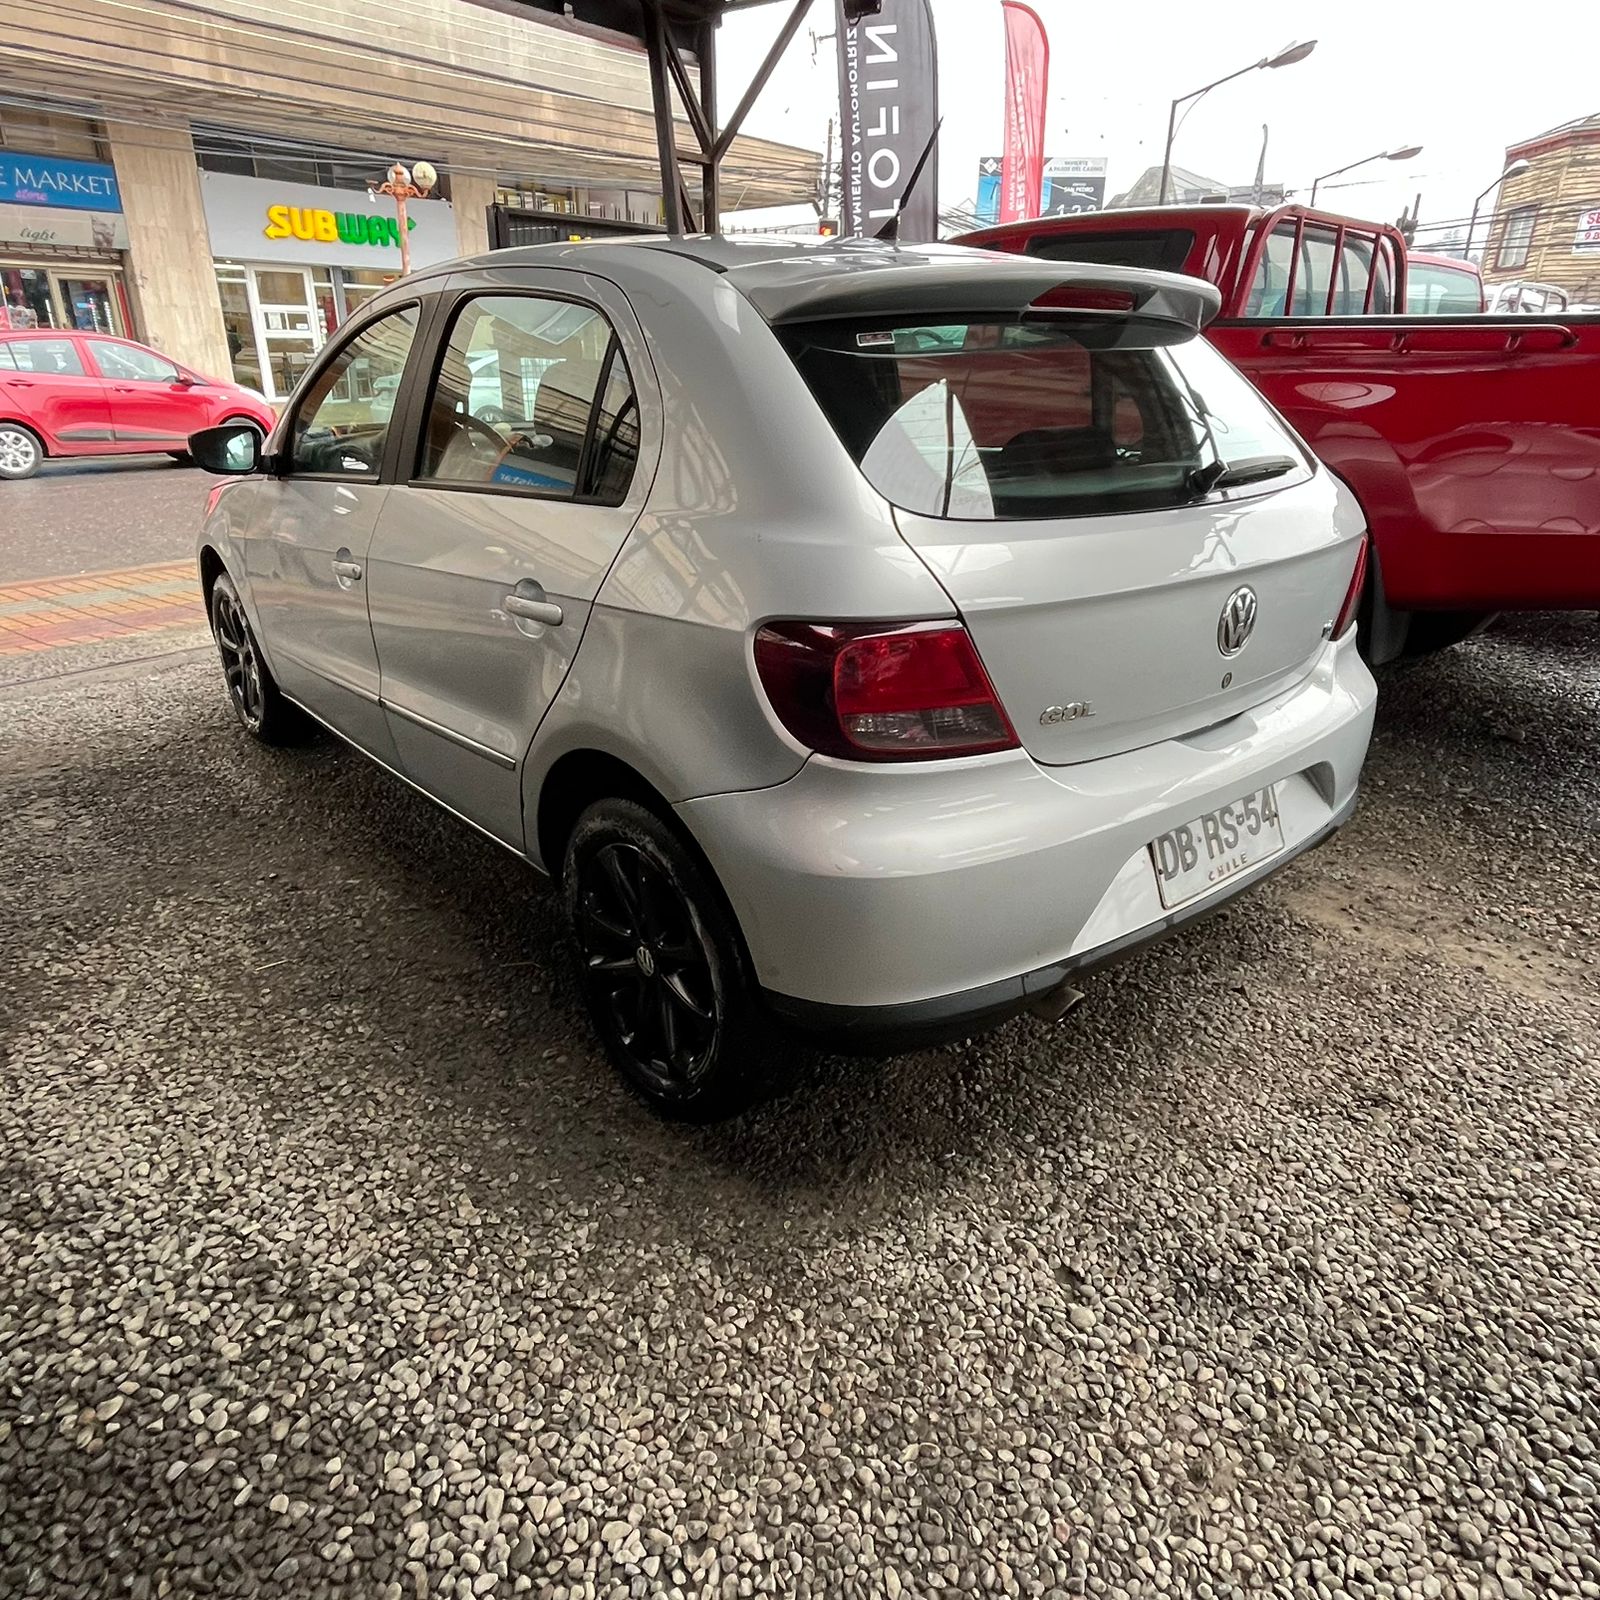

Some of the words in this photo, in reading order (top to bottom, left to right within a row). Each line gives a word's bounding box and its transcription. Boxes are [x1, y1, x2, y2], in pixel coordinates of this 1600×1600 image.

[15, 167, 114, 196] MARKET
[20, 227, 57, 241] light
[264, 204, 417, 248] SUBWAY
[1040, 700, 1097, 725] GOL
[1208, 852, 1248, 881] CHILE
